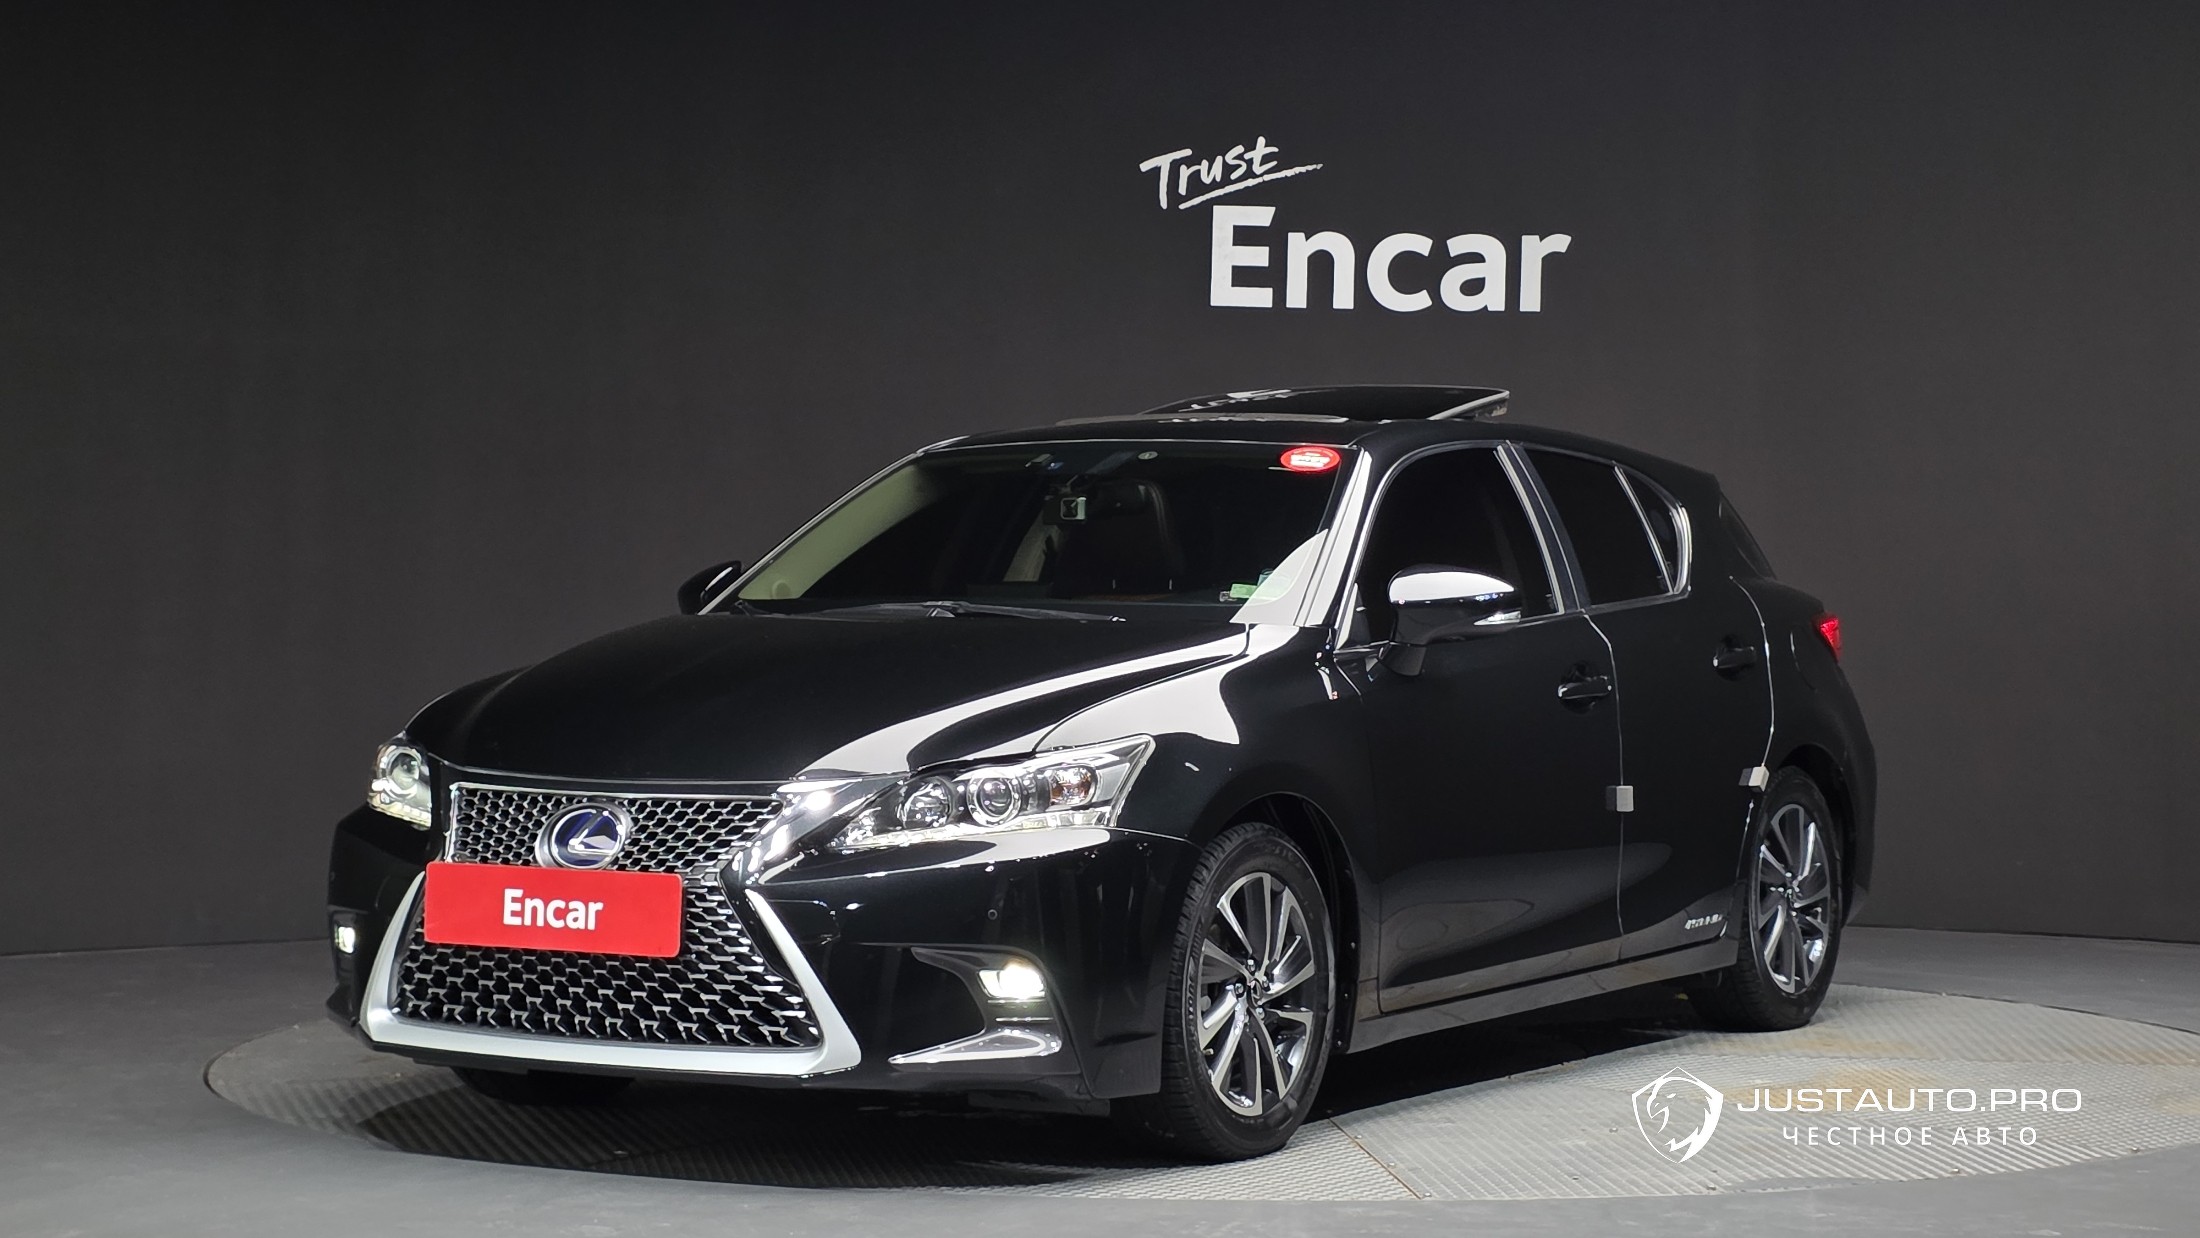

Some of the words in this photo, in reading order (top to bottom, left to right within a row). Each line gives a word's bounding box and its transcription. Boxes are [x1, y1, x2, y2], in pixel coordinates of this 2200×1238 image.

[1139, 136, 1279, 210] Trust
[1210, 205, 1572, 313] Encar
[503, 888, 604, 931] Encar
